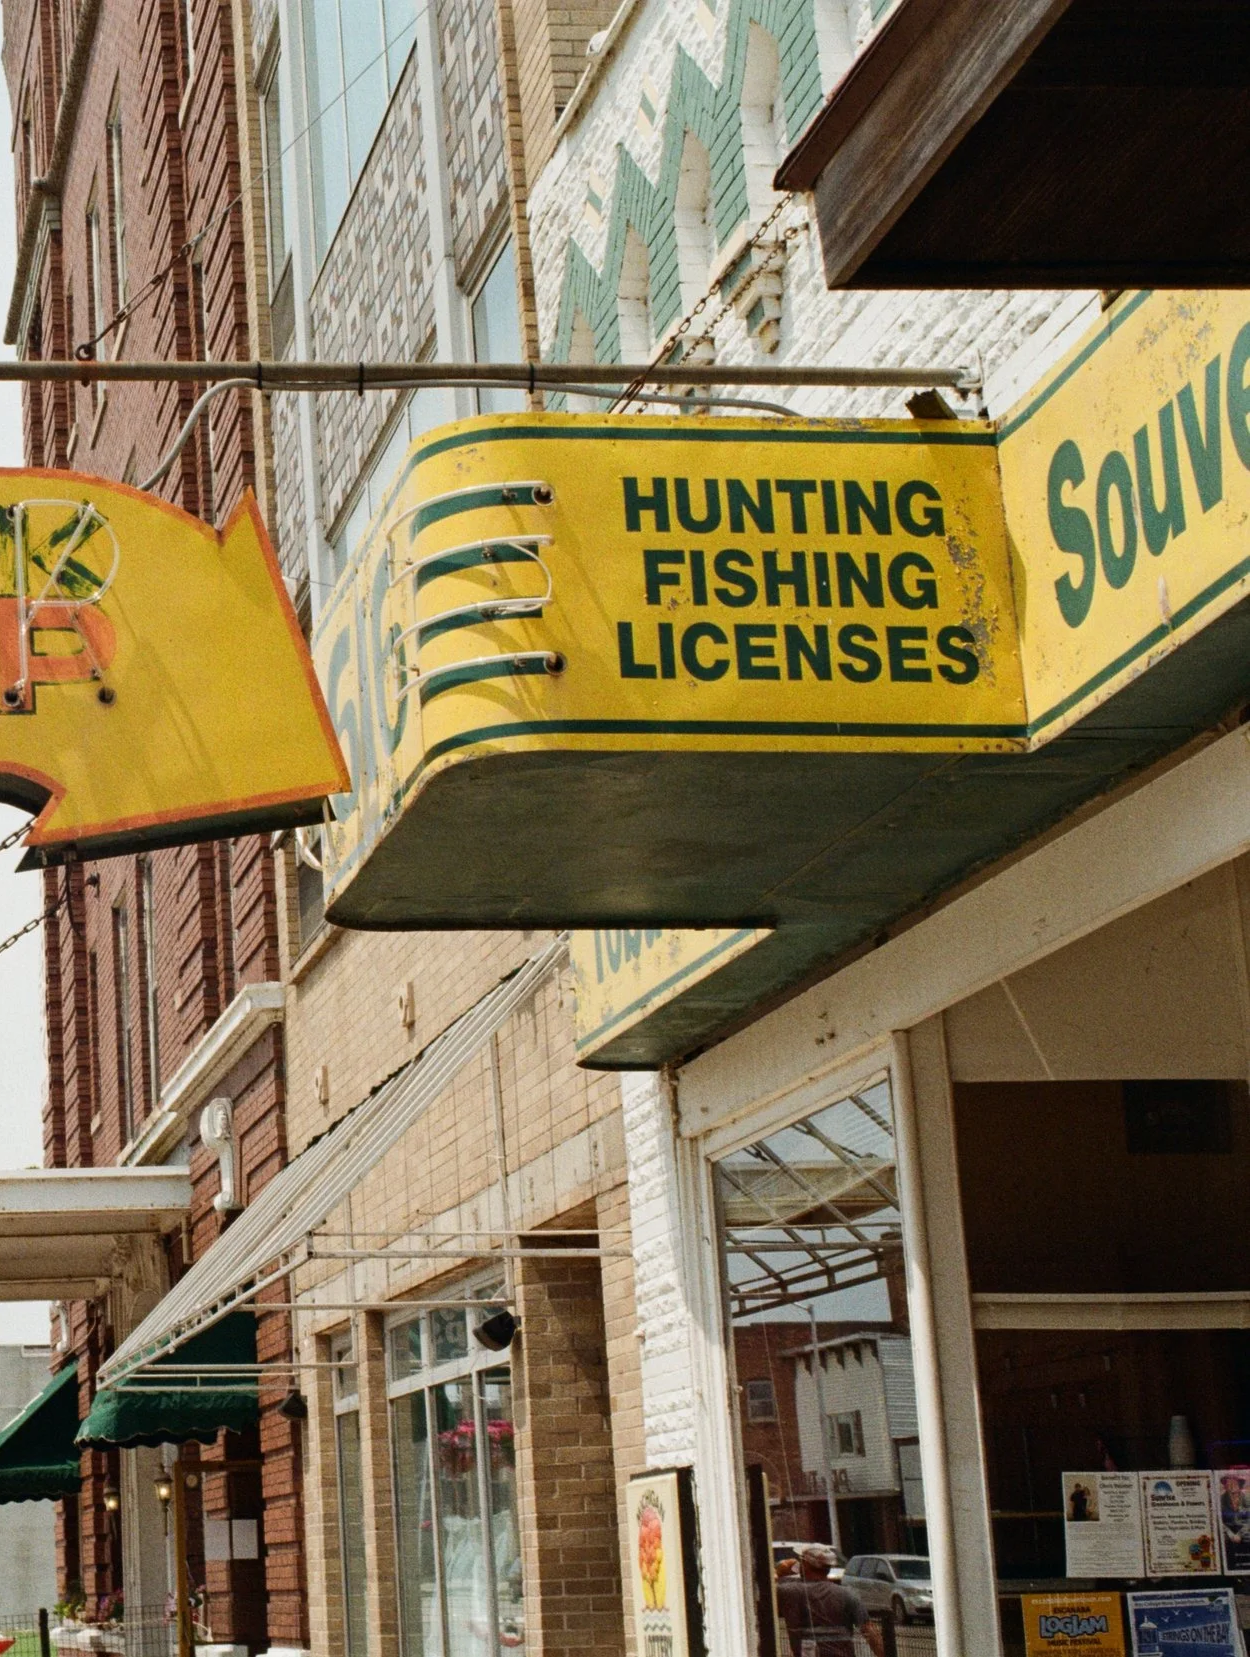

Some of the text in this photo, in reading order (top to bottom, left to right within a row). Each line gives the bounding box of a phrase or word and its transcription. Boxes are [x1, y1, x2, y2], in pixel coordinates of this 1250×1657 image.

[621, 476, 945, 537] HUNTING
[642, 548, 939, 609] FISHING
[616, 621, 981, 686] LICENSES
